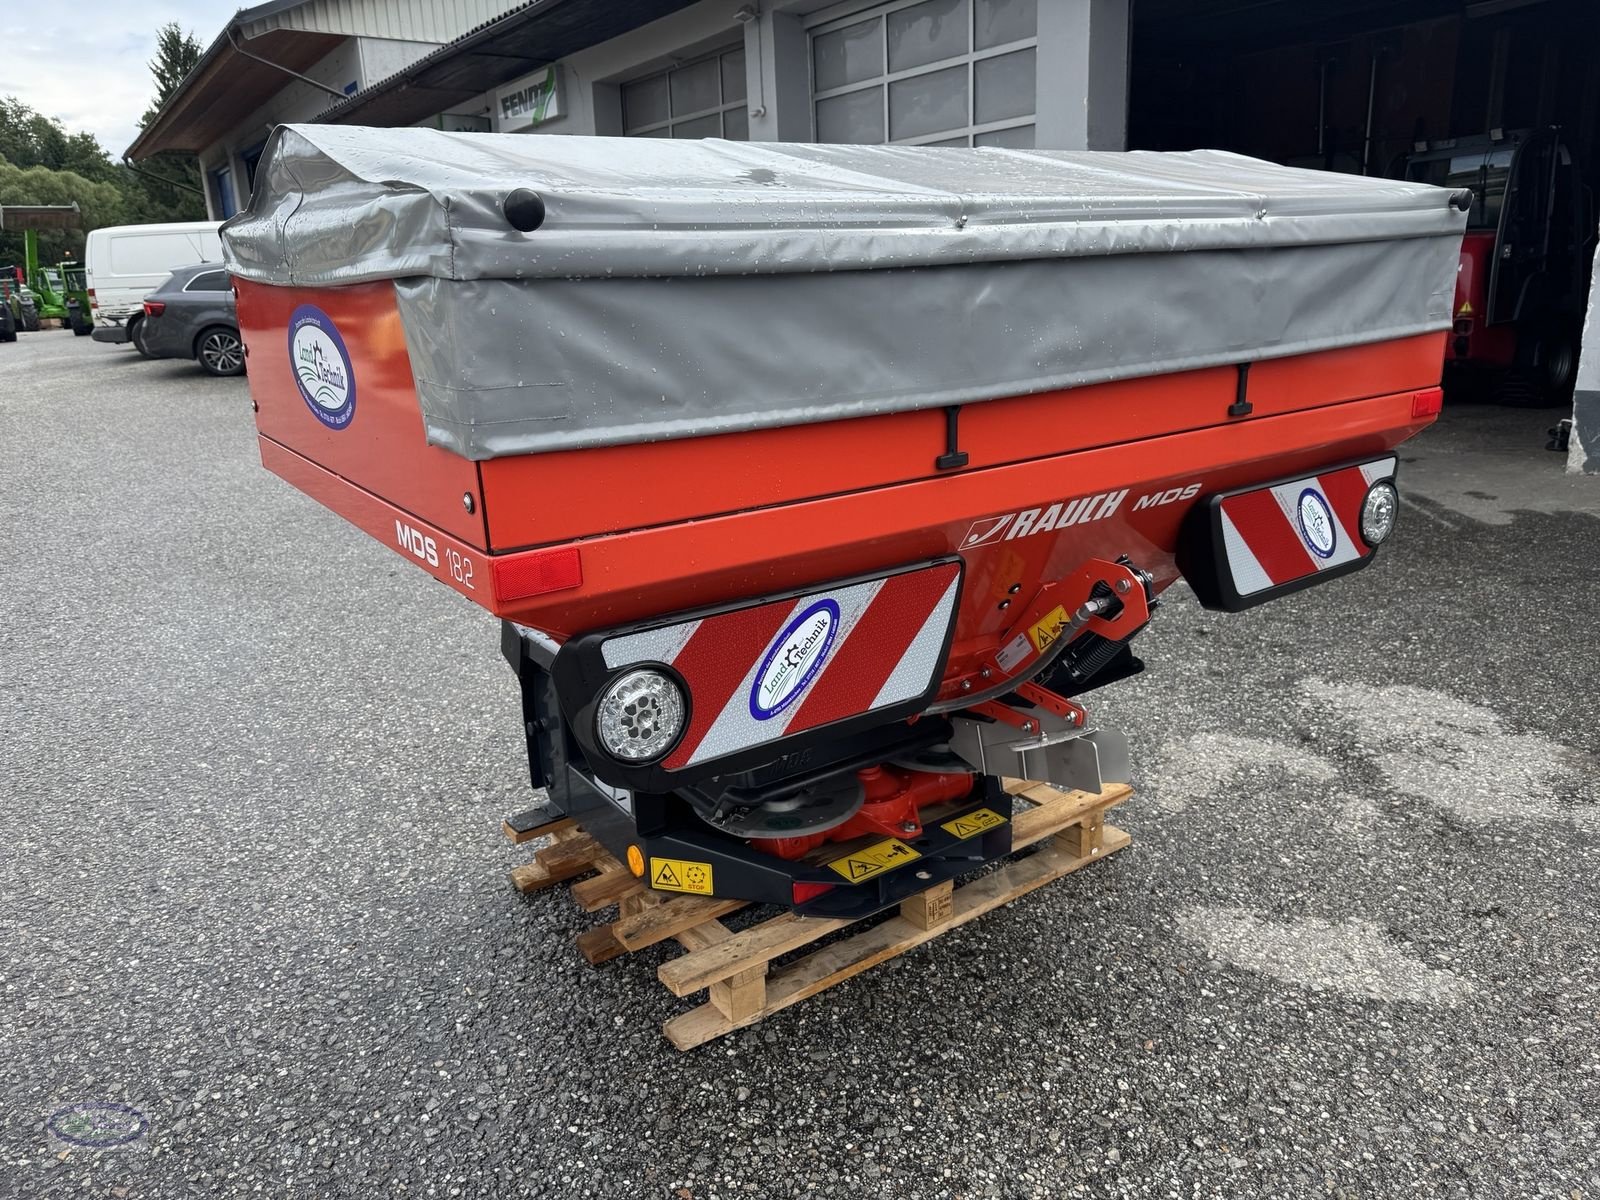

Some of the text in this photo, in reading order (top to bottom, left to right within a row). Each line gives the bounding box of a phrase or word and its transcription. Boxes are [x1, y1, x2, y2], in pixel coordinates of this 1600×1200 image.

[1005, 483, 1202, 541] RAUCH MDS
[396, 520, 475, 590] MDS 18.2
[794, 618, 828, 661] Technik
[764, 663, 788, 694] Land
